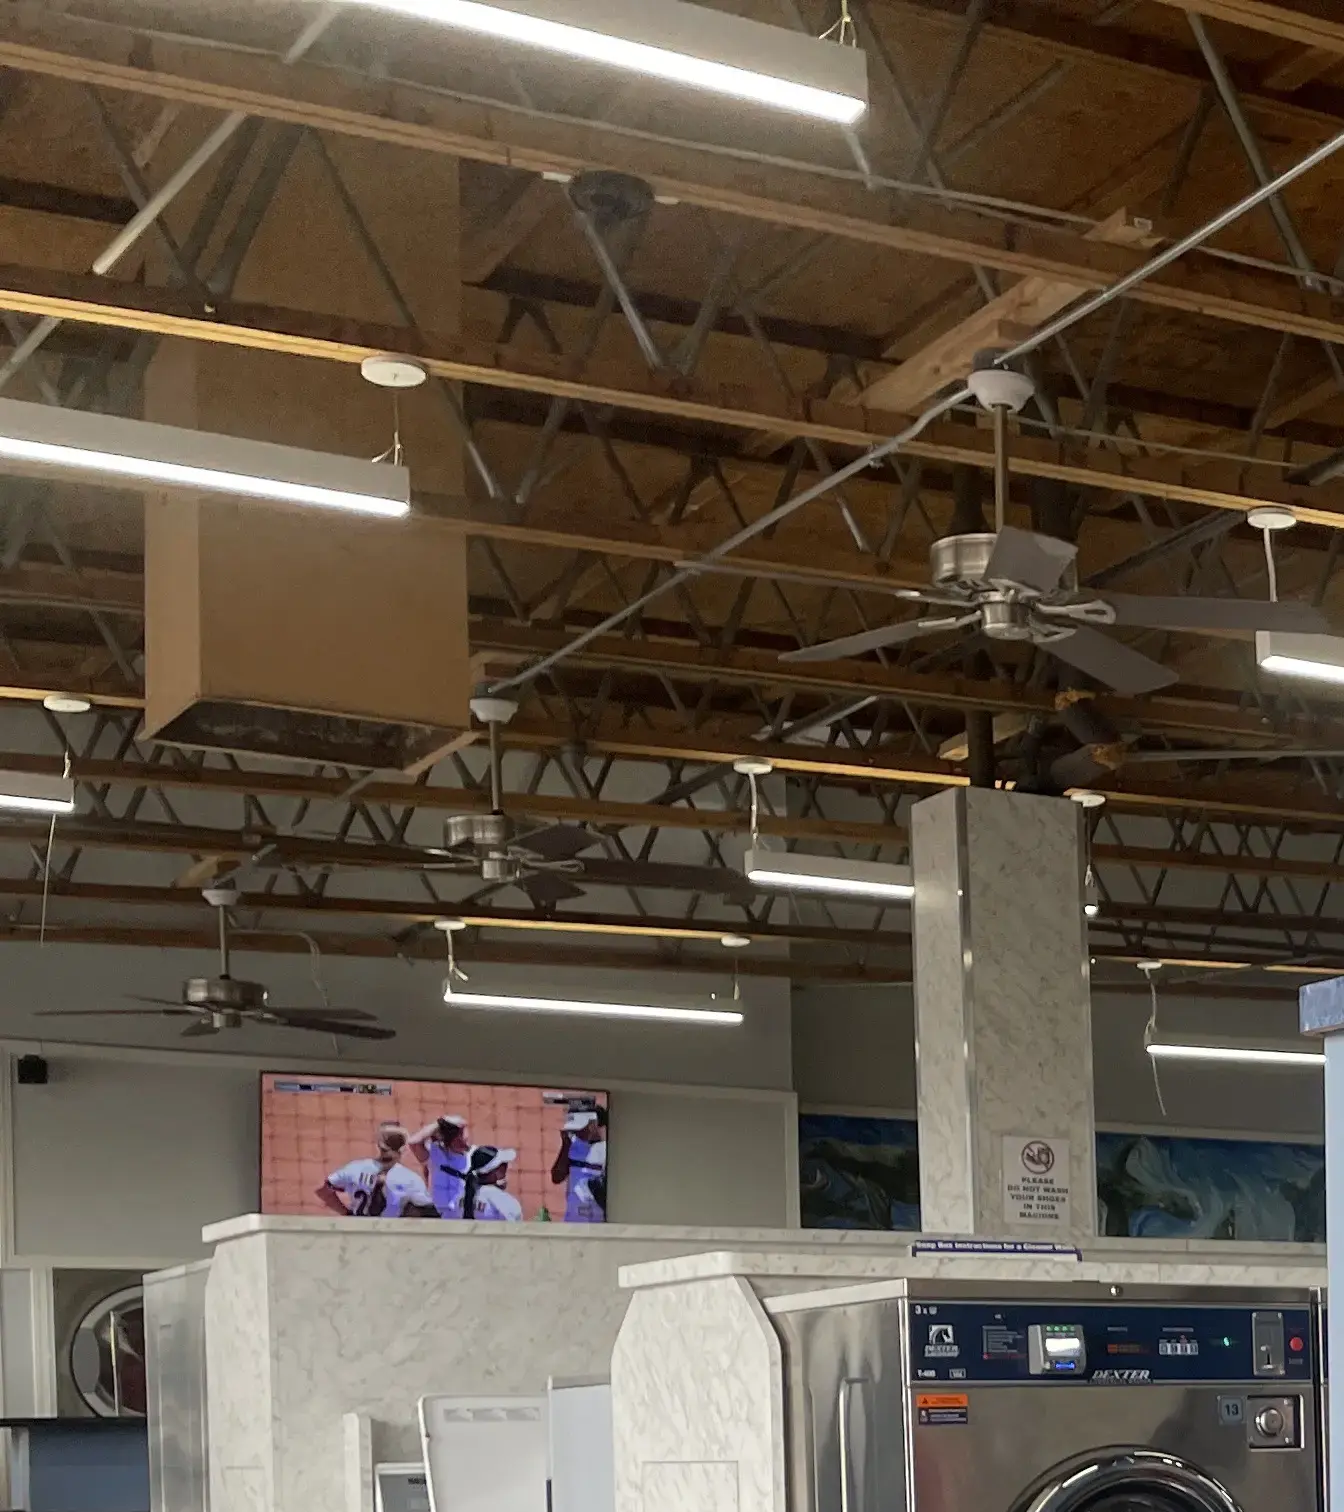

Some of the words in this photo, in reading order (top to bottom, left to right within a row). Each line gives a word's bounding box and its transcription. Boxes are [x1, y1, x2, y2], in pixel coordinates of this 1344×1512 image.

[1021, 1177, 1054, 1185] PLEASE
[1091, 1369, 1150, 1380] DEXTER
[1224, 1403, 1239, 1416] 13
